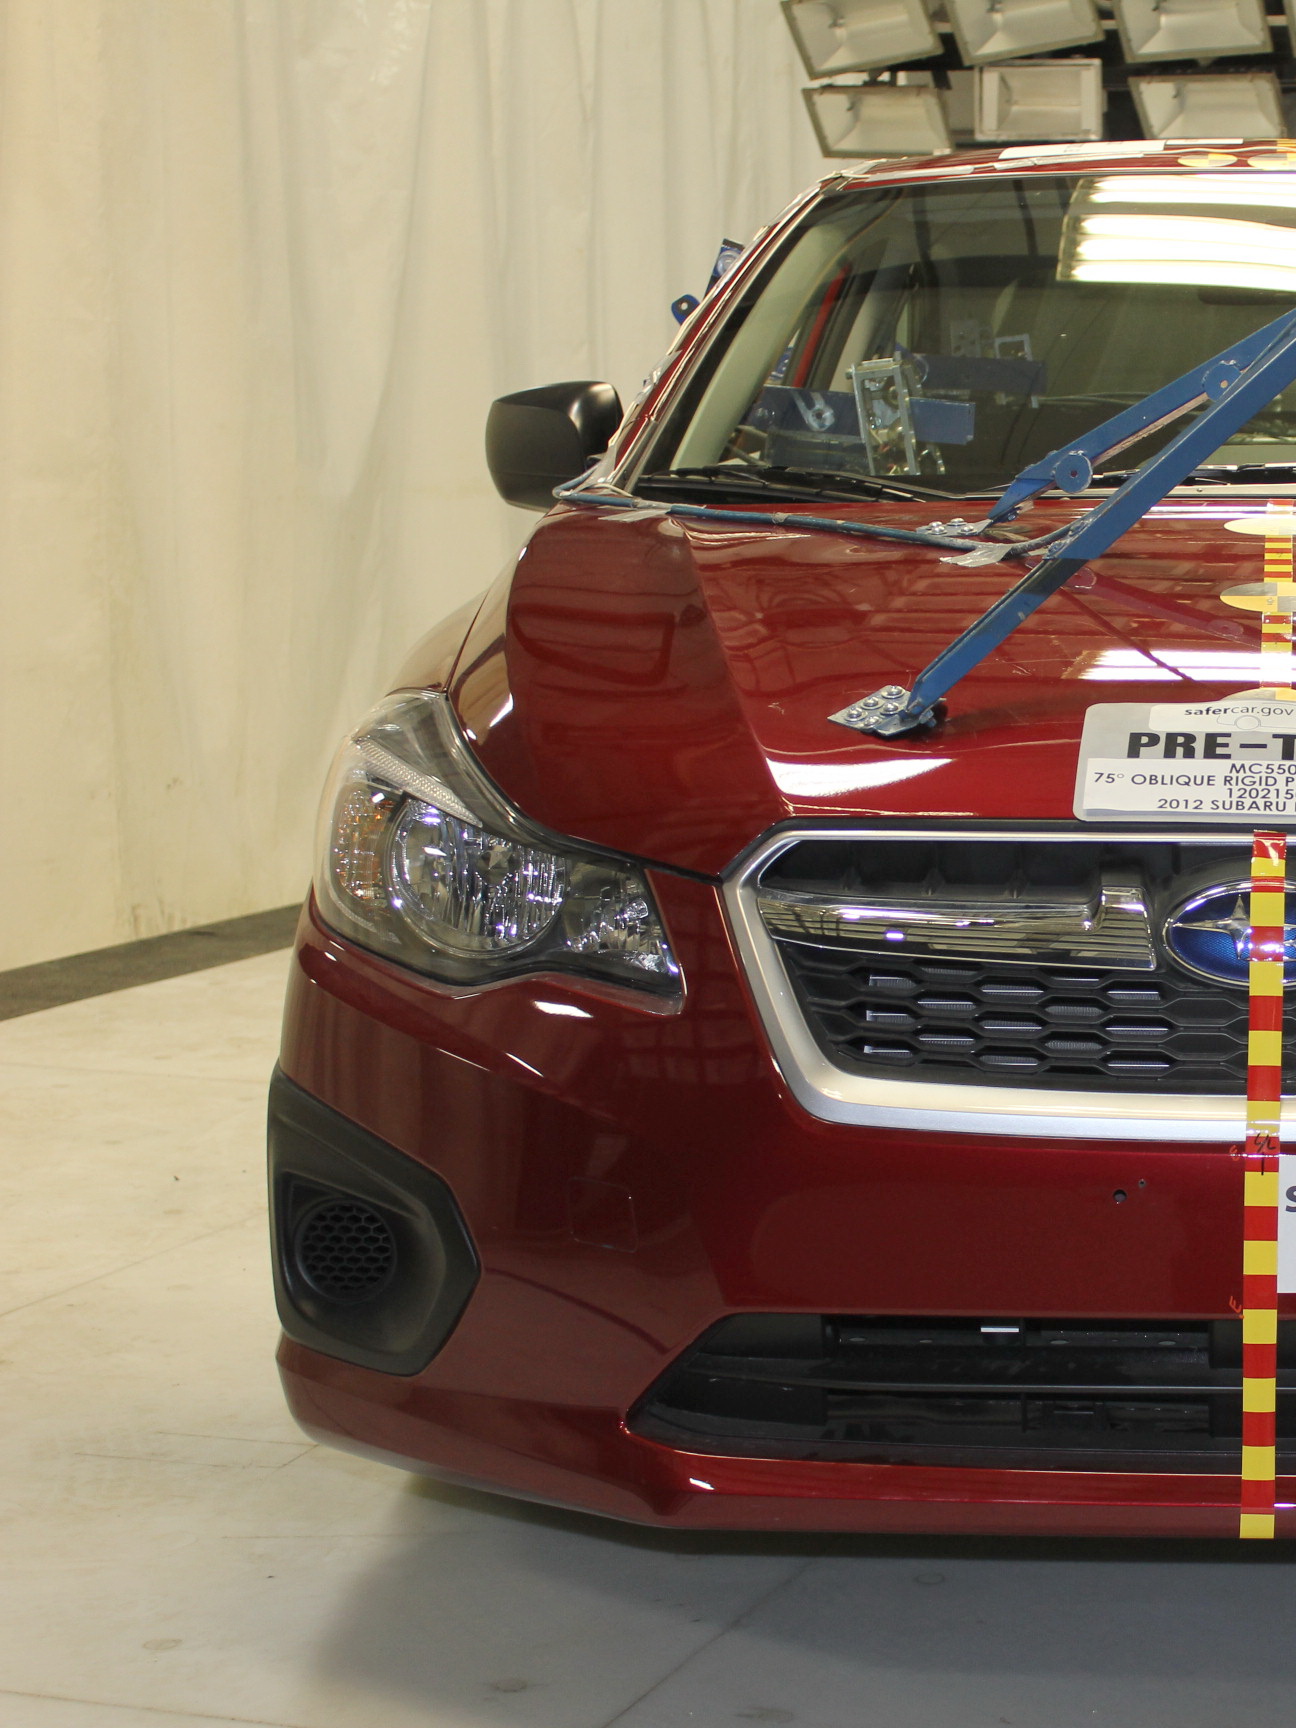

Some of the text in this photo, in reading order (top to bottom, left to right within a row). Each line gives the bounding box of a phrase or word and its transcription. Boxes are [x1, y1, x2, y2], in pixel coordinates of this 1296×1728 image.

[1184, 706, 1294, 717] safercar.gov
[1131, 774, 1216, 787] OBLIQUE
[1223, 775, 1278, 787] RIGID
[1157, 798, 1204, 810] 2012
[1210, 799, 1287, 812] SUBARU
